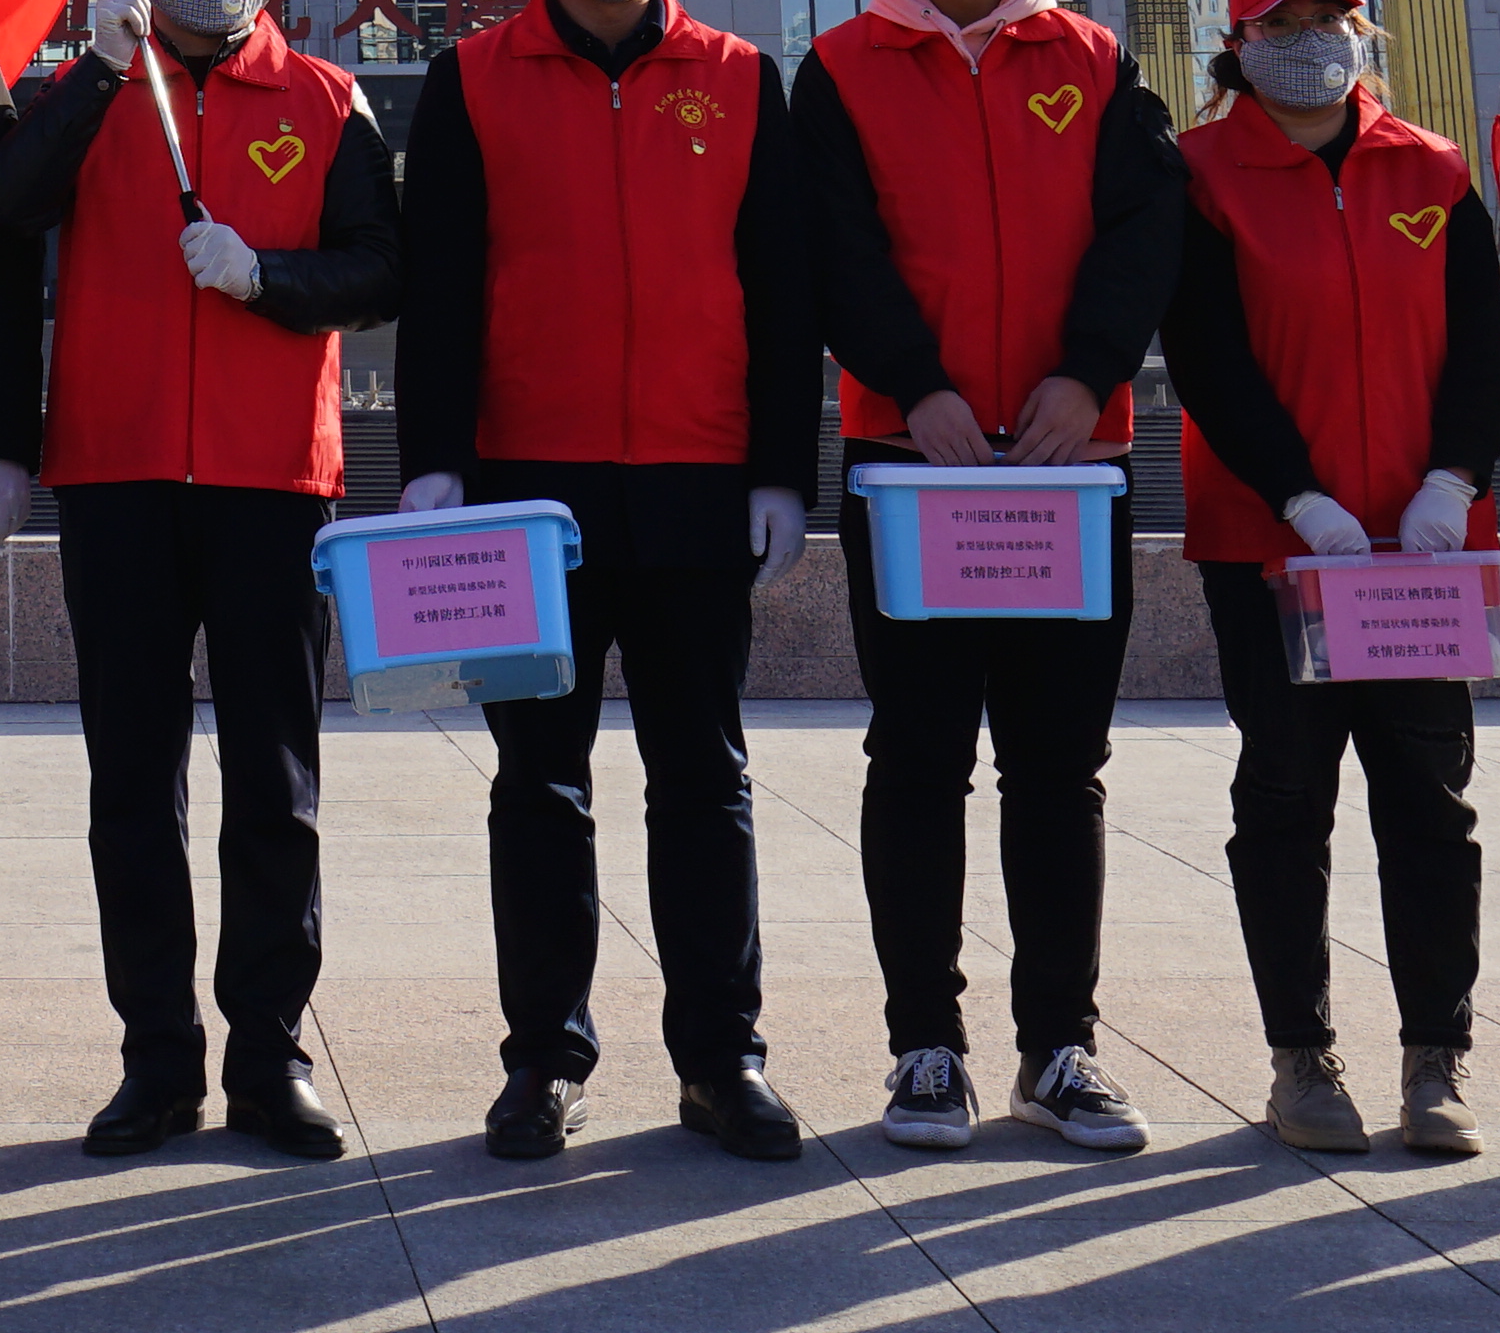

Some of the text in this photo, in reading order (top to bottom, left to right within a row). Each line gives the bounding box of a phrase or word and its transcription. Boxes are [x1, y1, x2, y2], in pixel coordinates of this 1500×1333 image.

[951, 509, 1057, 524] 中川园区栖霞街道
[955, 540, 1055, 552] 新型冠状病毒感染肺炎
[401, 549, 506, 570] 中川园区栖霞街道
[959, 565, 1052, 580] 疫情防控工具箱
[407, 579, 507, 597] 新型冠状病毒感染肺炎
[1354, 585, 1461, 602] 中川园区栖霞街道
[413, 603, 506, 624] 疫情防控工具箱
[1360, 617, 1461, 630] 新型冠状病毒感染肺炎
[1367, 643, 1461, 659] 疫情防控工具箱
